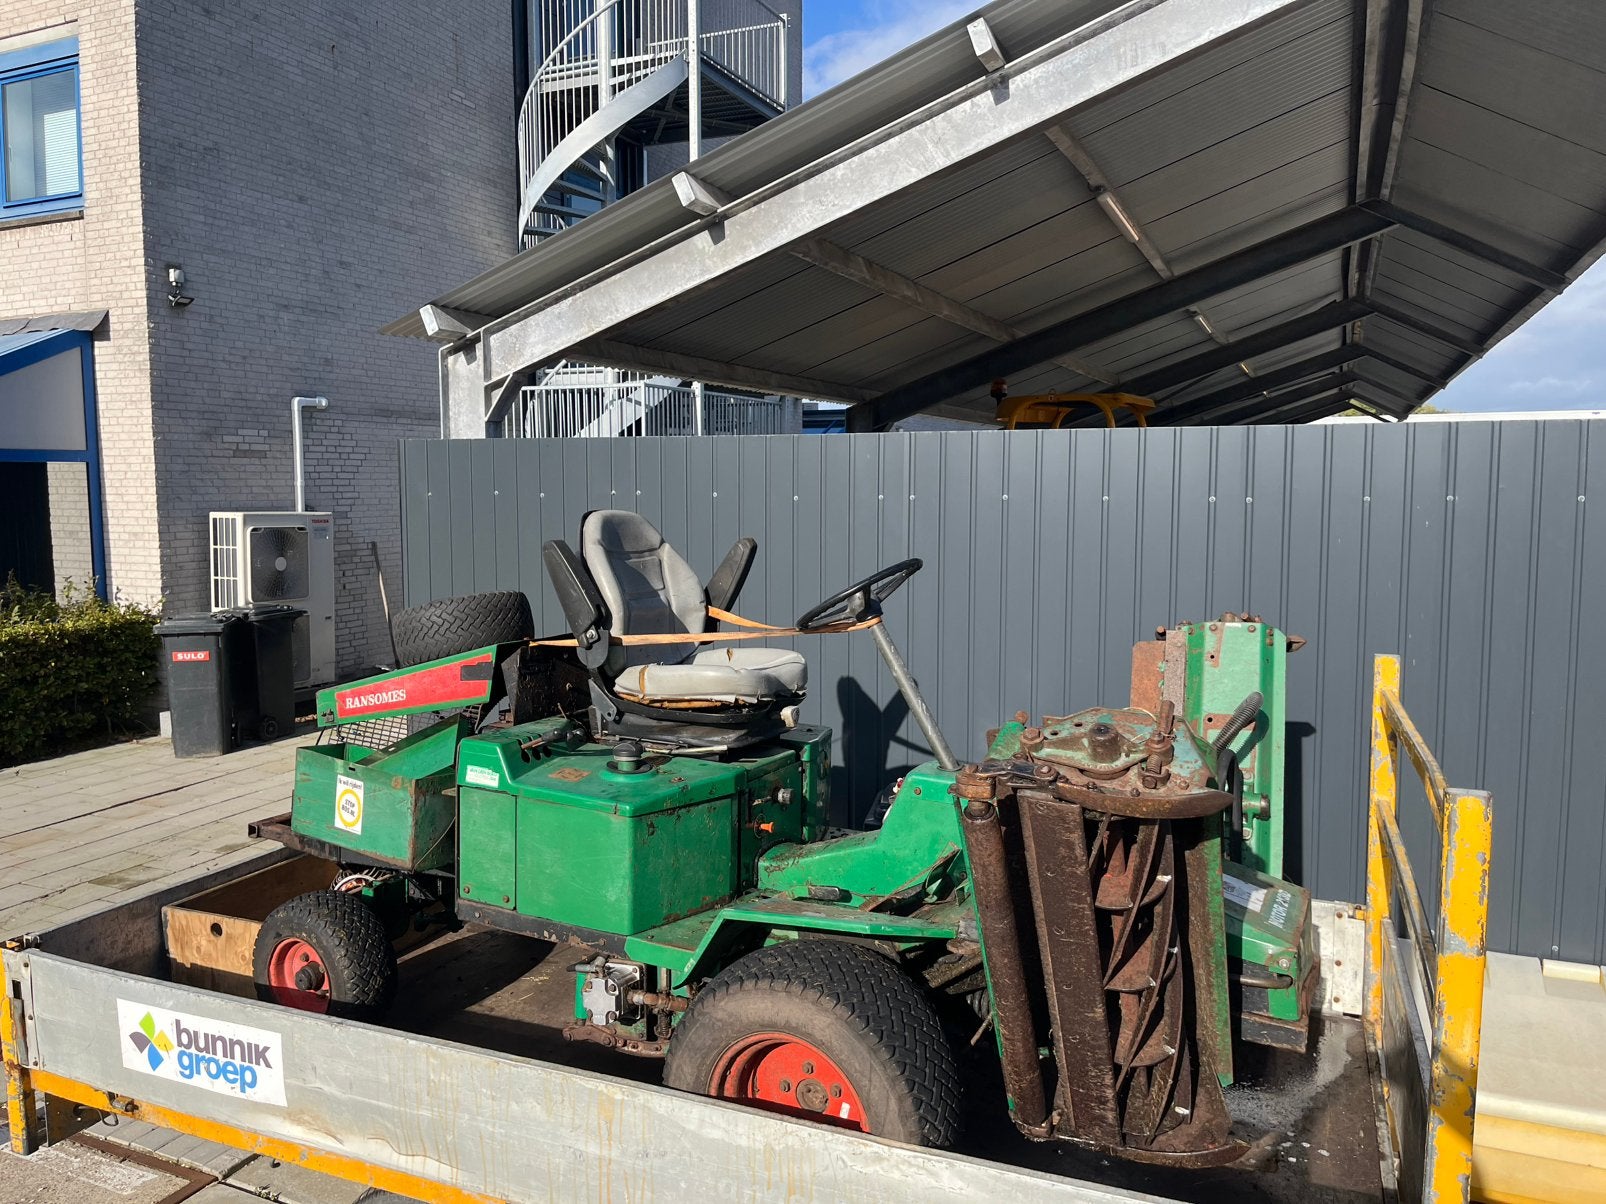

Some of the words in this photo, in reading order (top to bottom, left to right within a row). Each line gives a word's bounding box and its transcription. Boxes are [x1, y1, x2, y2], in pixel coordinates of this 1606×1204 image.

[345, 689, 407, 709] RANSOMES
[1268, 904, 1288, 929] MOTOR
[174, 1018, 273, 1069] bunnik
[177, 1049, 258, 1094] groep
